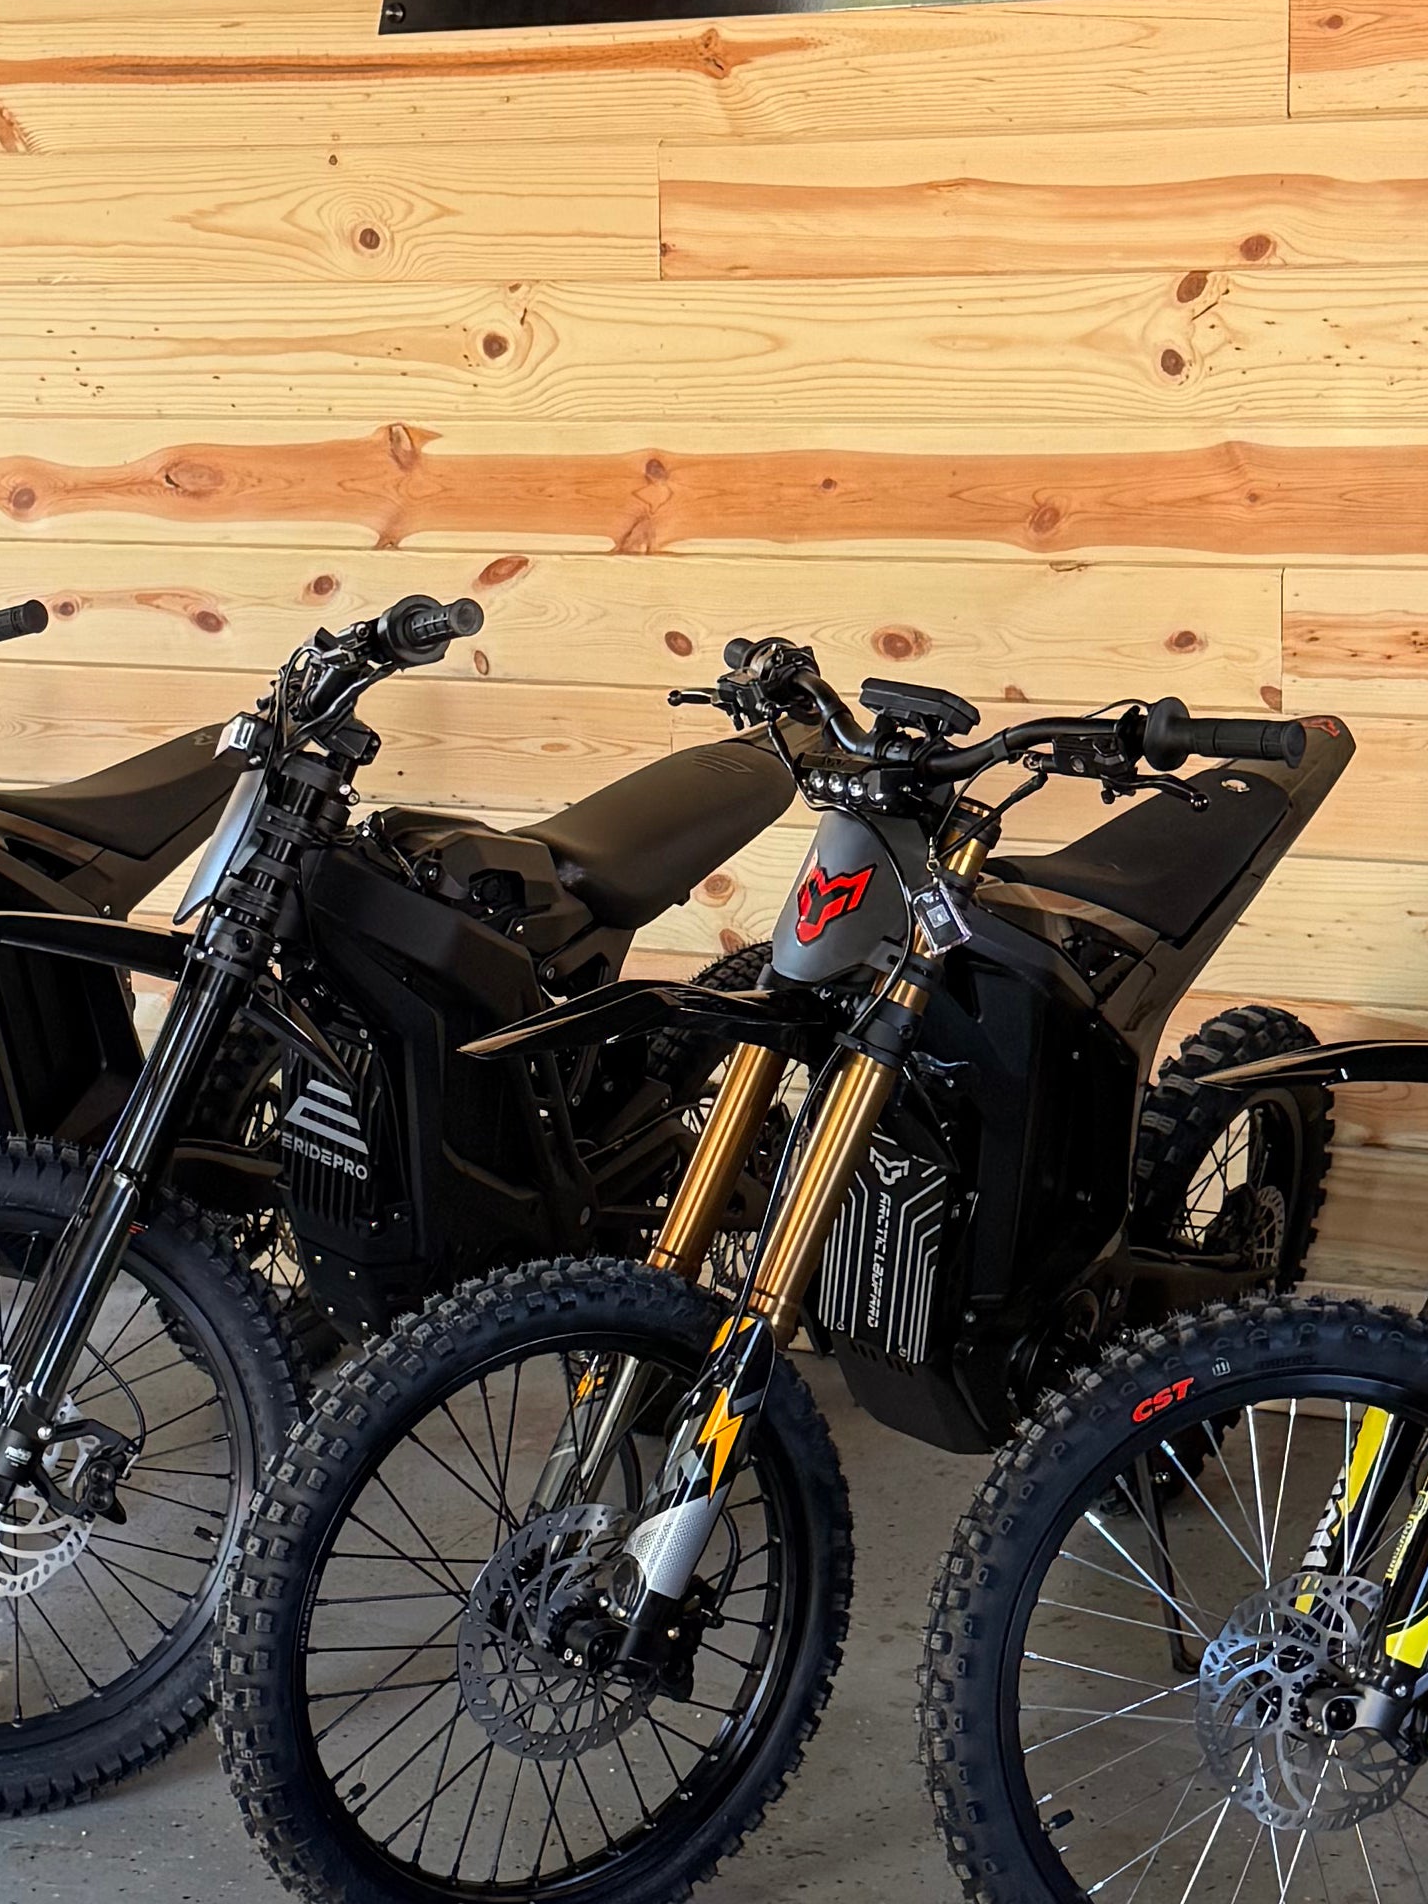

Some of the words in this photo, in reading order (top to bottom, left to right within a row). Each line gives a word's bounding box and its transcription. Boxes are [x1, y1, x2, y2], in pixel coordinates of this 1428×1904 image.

[281, 1131, 368, 1180] ERIDEPRO
[874, 1191, 892, 1254] ARCTIC
[1131, 1376, 1195, 1424] CST
